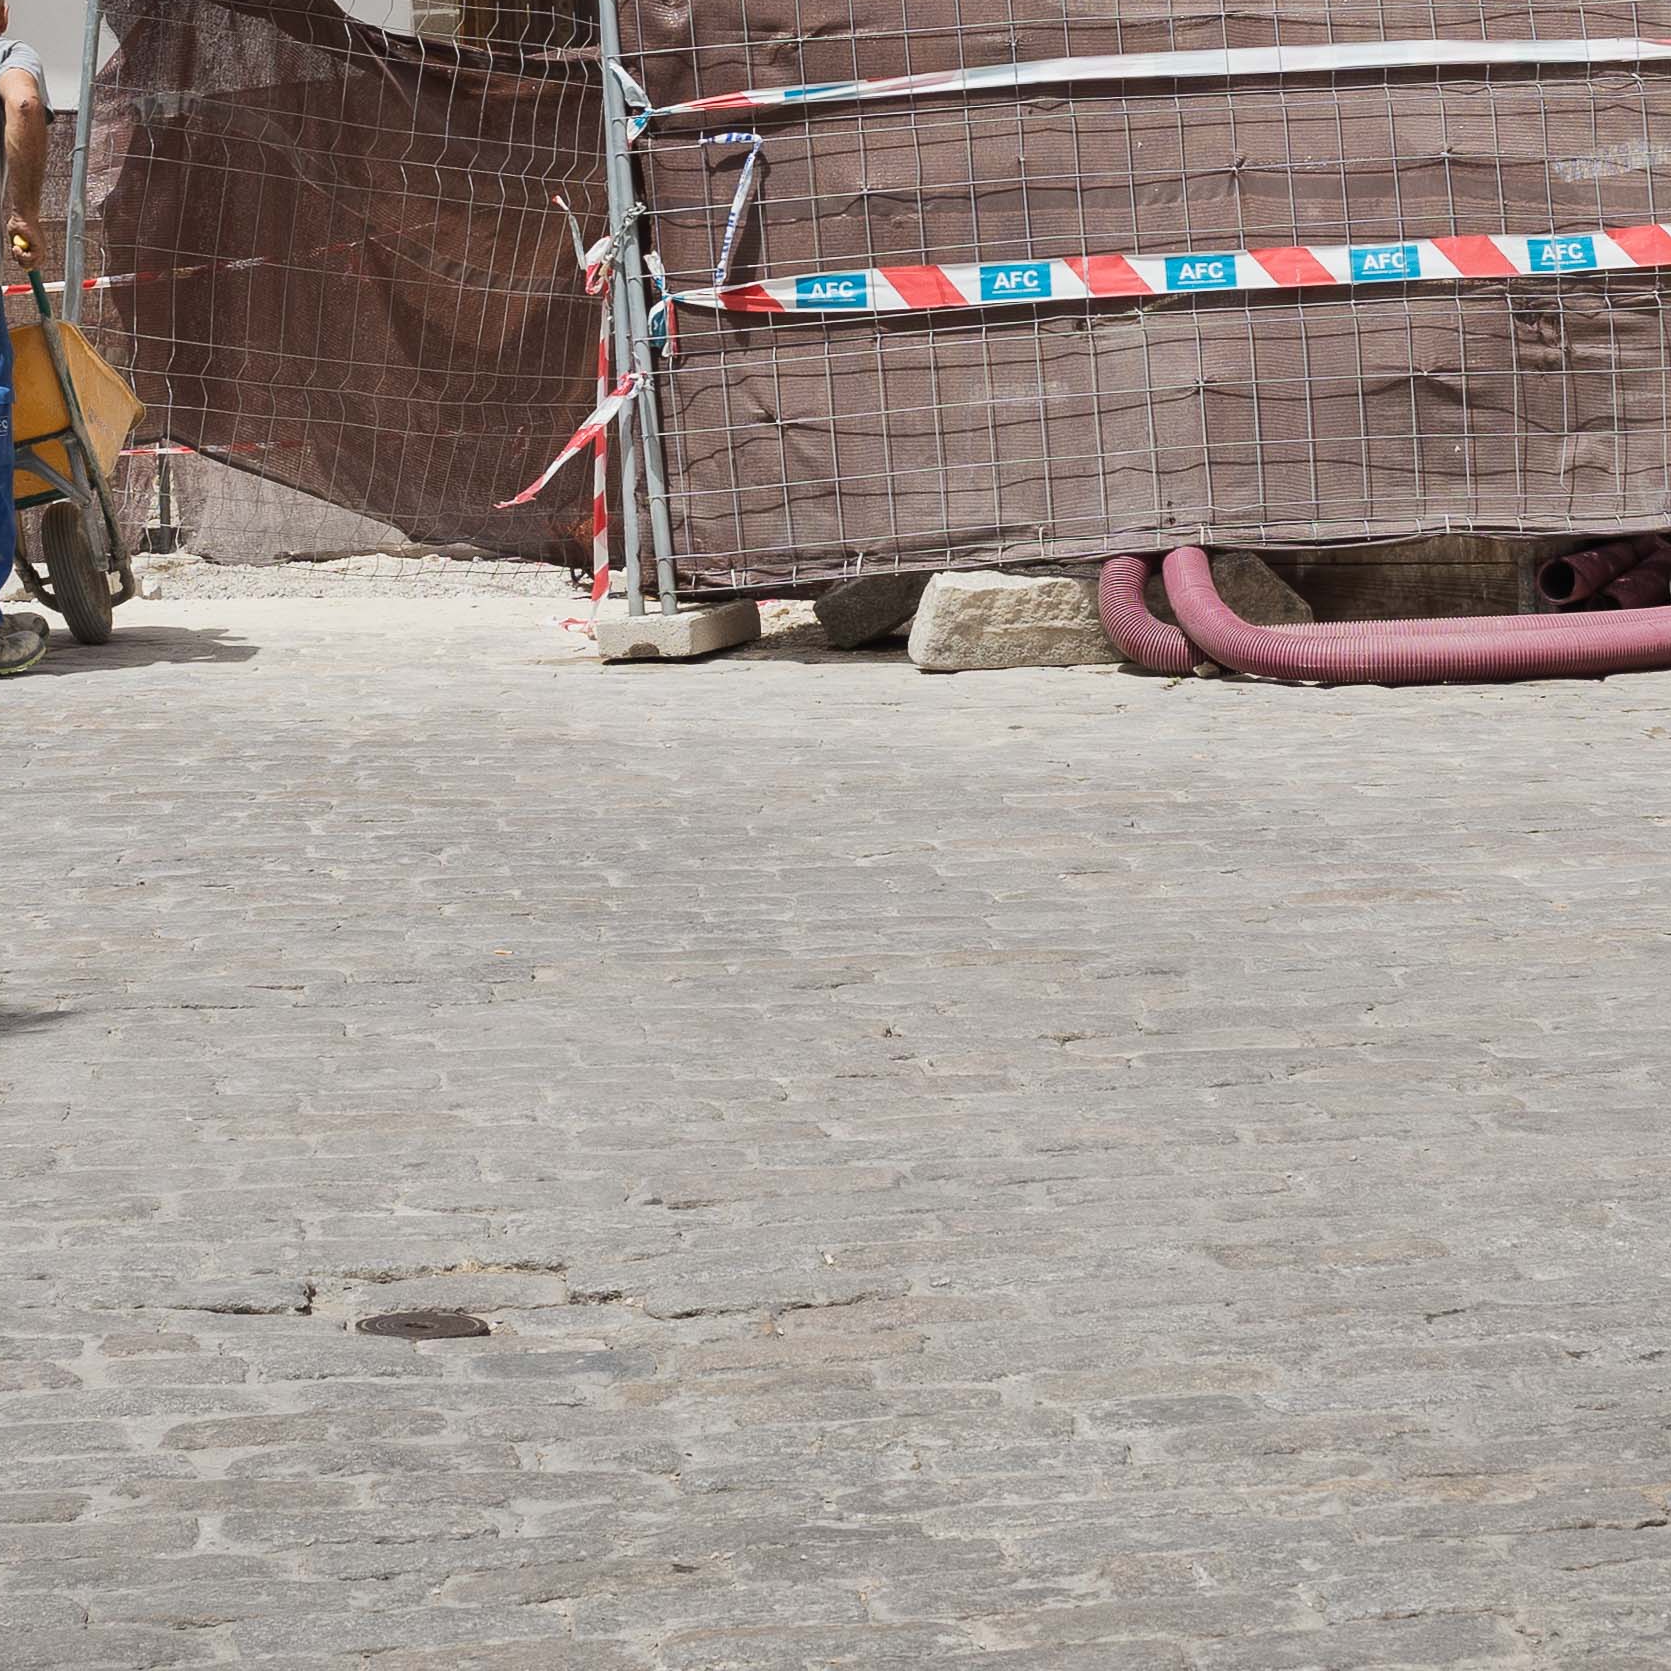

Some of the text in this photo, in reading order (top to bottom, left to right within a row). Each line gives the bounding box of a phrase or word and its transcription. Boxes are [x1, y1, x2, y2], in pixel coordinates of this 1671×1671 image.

[1363, 251, 1406, 271] AFC
[1541, 242, 1584, 262] AFC
[993, 270, 1039, 290] AFC
[1179, 262, 1224, 281] AFC
[810, 281, 855, 299] AFC
